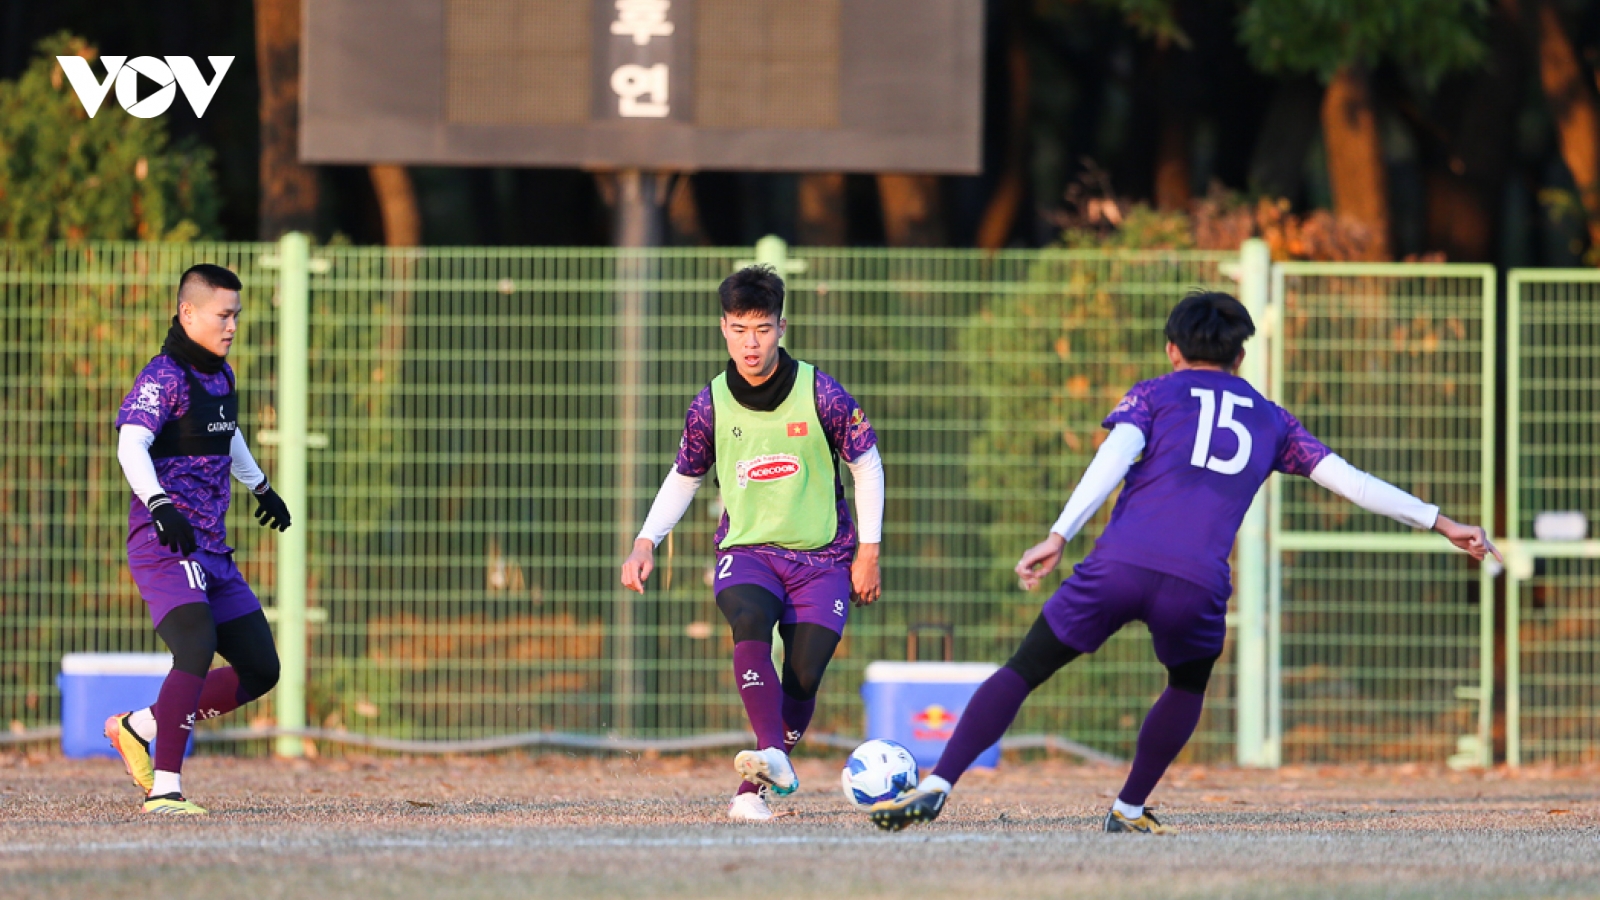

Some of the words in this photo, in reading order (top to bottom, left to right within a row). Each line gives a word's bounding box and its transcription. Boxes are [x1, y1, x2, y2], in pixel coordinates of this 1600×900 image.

[1190, 386, 1254, 475] 15
[179, 560, 207, 591] 10
[718, 554, 734, 580] 2
